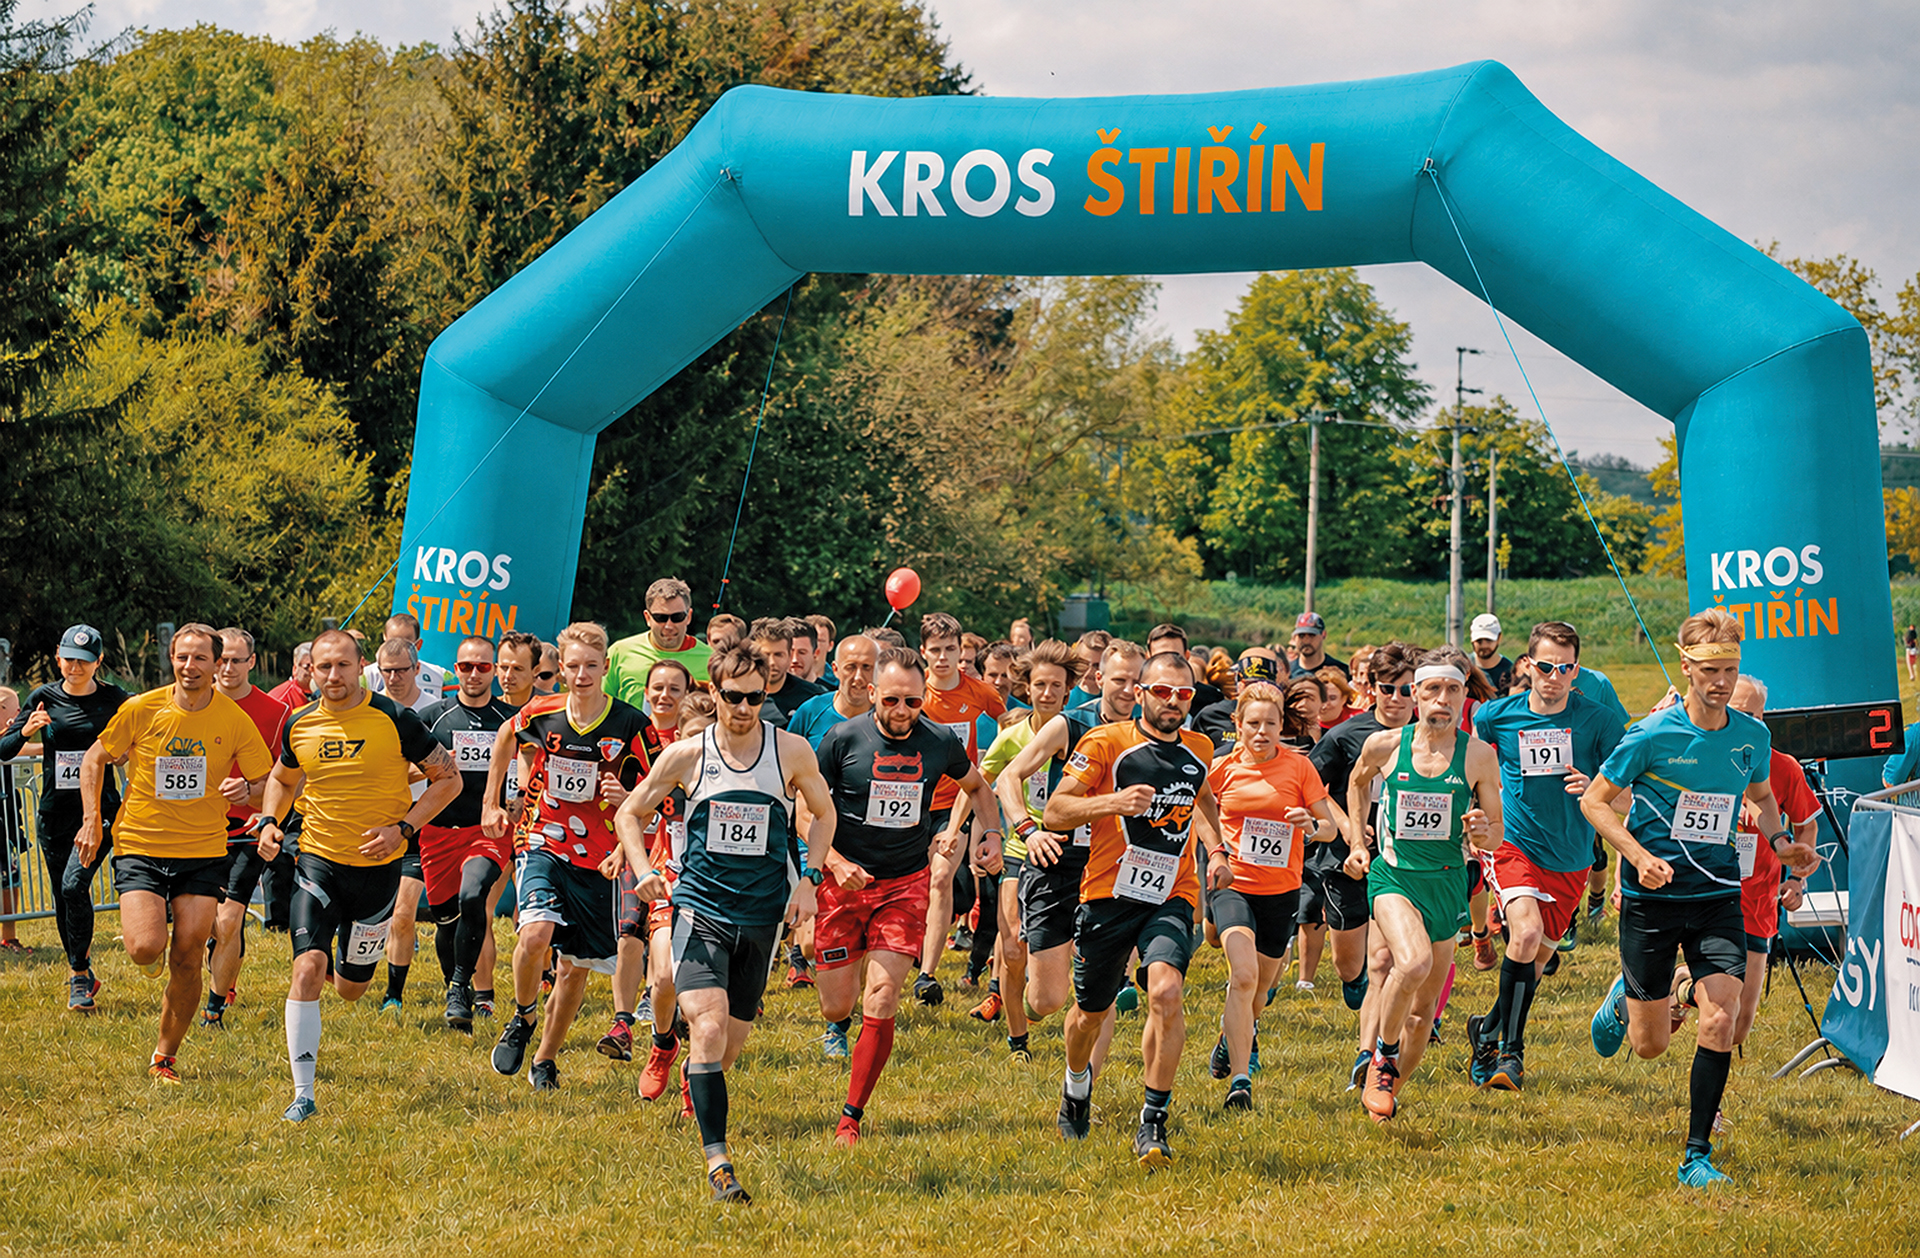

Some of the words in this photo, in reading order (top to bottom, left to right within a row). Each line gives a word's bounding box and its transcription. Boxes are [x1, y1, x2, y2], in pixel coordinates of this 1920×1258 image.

[848, 148, 1056, 218] KROS
[1083, 122, 1326, 217] ŠTIŘÍN
[413, 545, 513, 591] KROS
[1711, 544, 1824, 591] KROS
[407, 583, 519, 639] ŠTIŘÍN
[1713, 587, 1839, 642] TIŘÍN
[1869, 709, 1893, 749] 2
[460, 746, 492, 762] 534
[1529, 747, 1561, 765] 191
[164, 774, 198, 790] 585
[556, 774, 588, 793] 169
[879, 800, 912, 817] 192
[1404, 811, 1443, 829] 549
[1683, 811, 1720, 832] 551
[719, 822, 758, 843] 184
[1251, 835, 1283, 856] 196
[1129, 866, 1167, 892] 194
